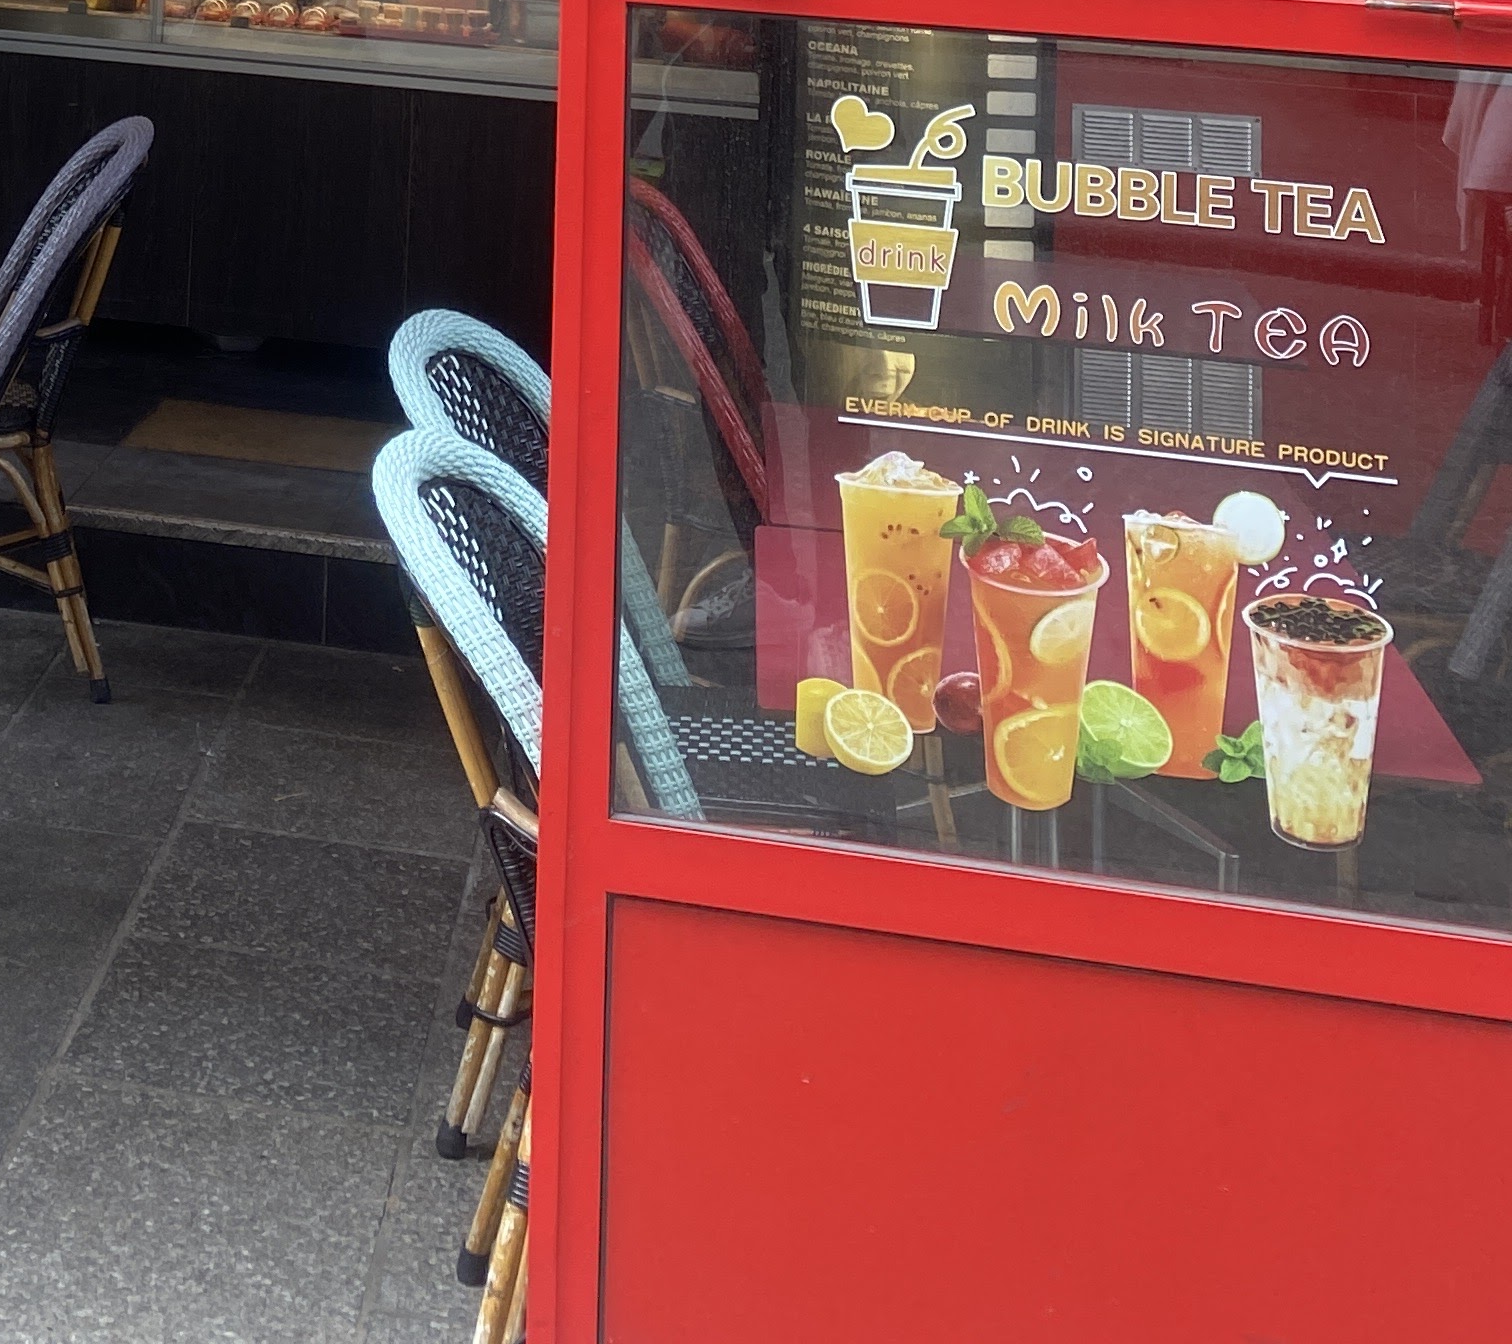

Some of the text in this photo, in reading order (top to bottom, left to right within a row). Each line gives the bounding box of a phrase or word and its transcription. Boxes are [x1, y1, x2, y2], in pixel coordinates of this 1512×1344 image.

[807, 40, 859, 56] OCEANA
[807, 77, 890, 97] NAPOLITAINE
[806, 112, 822, 123] LA
[805, 149, 852, 165] ROYALE
[804, 185, 879, 207] HAWAÏENE
[981, 154, 1386, 245] BUBBLE TEA
[906, 211, 938, 222] ananas
[803, 223, 811, 234] 4
[858, 238, 948, 276] drink
[993, 279, 1371, 368] Milk TEA
[845, 396, 1389, 472] EVERY CUP OF DRINK IS SIGNATURE PRODUCT
